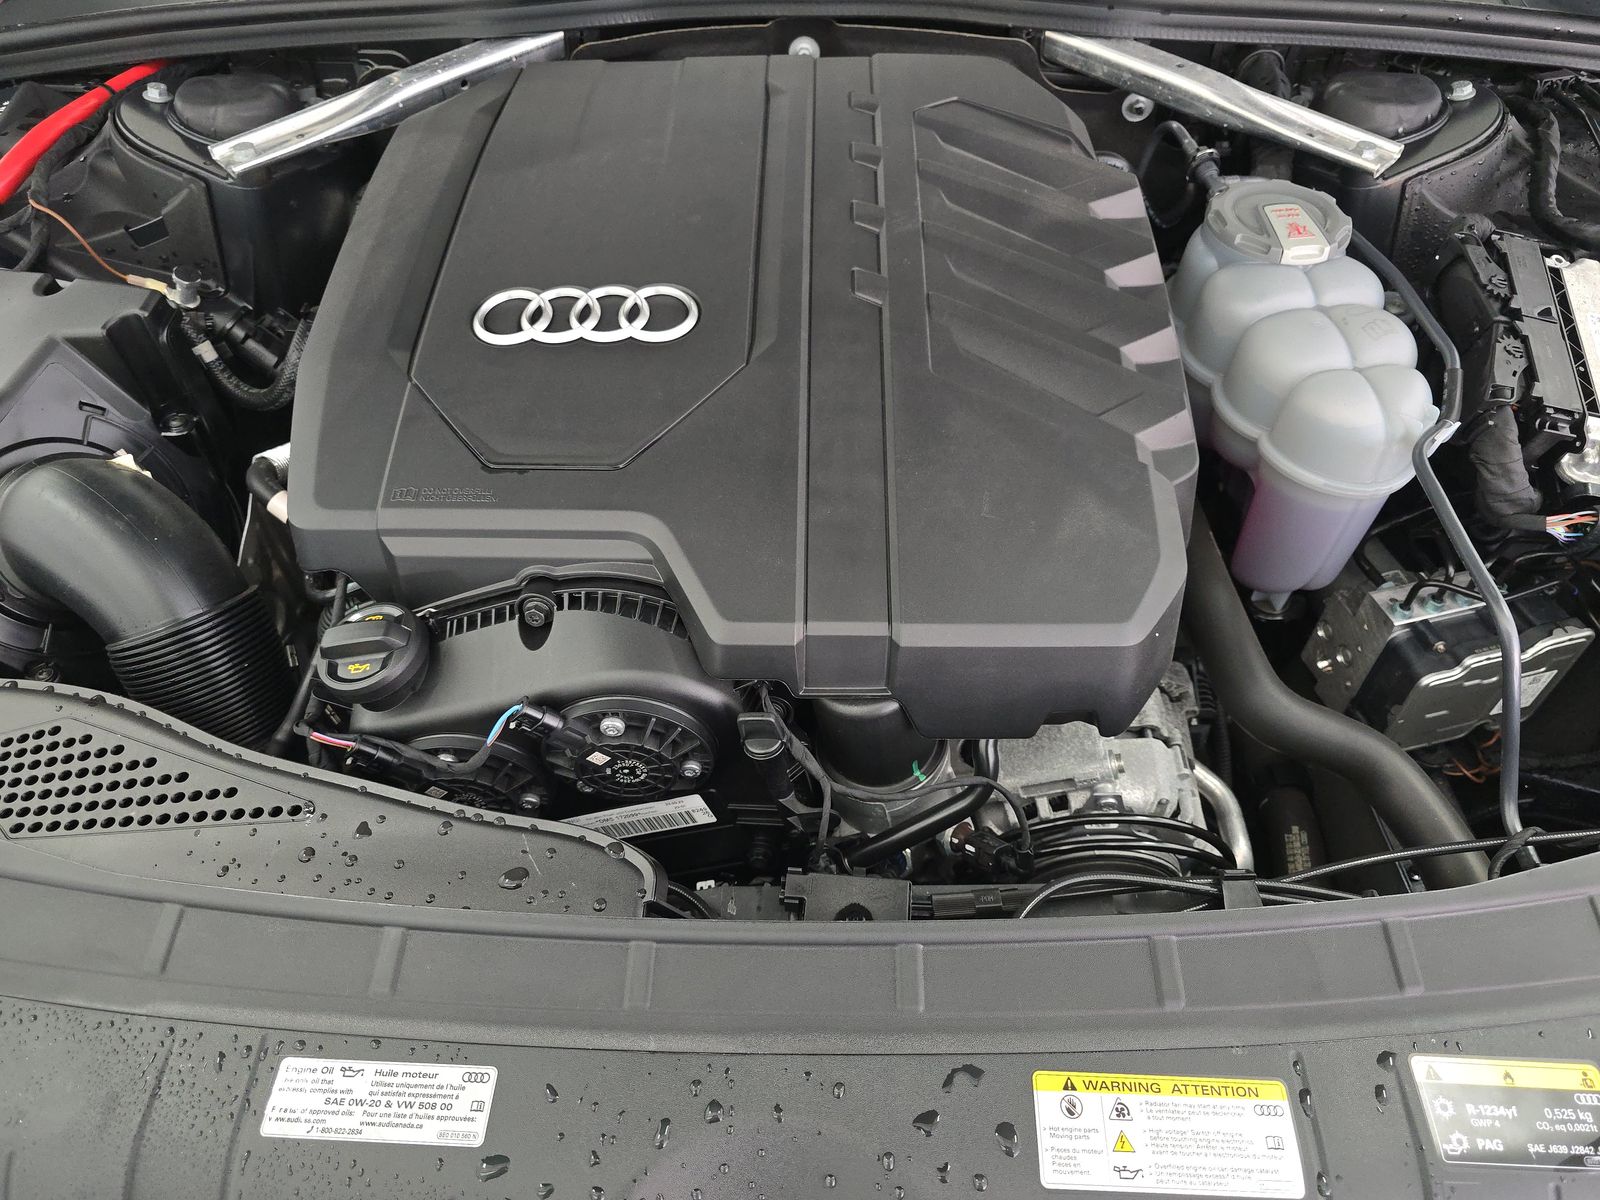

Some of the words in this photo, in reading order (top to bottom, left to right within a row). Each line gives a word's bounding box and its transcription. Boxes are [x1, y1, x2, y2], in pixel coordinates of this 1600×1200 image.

[285, 1065, 318, 1075] Engine
[321, 1066, 335, 1075] Oil
[374, 1068, 399, 1078] Huile
[401, 1070, 440, 1080] moteur
[370, 1080, 395, 1088] Utilisez
[396, 1081, 435, 1090] uniquement
[1082, 1079, 1162, 1094] WARNING
[1171, 1082, 1260, 1098] ATTENTION
[309, 1087, 338, 1095] complies
[368, 1090, 380, 1098] qui
[380, 1090, 407, 1098] satisfait
[324, 1097, 346, 1106] SAE
[348, 1098, 382, 1108] 0W-20
[384, 1100, 394, 1108] &
[396, 1100, 416, 1110] VW
[418, 1102, 438, 1110] 508
[440, 1102, 454, 1111] 00
[308, 1108, 340, 1117] approved
[362, 1110, 378, 1118] Pour
[1465, 1103, 1518, 1120] R-1234yf
[1544, 1107, 1576, 1120] 0,525
[1578, 1109, 1594, 1122] kg
[360, 1120, 424, 1130] www.audicanada.ca
[1470, 1118, 1495, 1128] GWP
[316, 1126, 363, 1136] 1-800-822-2834
[1555, 1124, 1566, 1133] eq
[1050, 1132, 1073, 1140] Moving
[1476, 1138, 1504, 1152] PAG
[1527, 1143, 1546, 1153] SAE
[1548, 1144, 1568, 1154] J639
[1570, 1145, 1595, 1155] J2842
